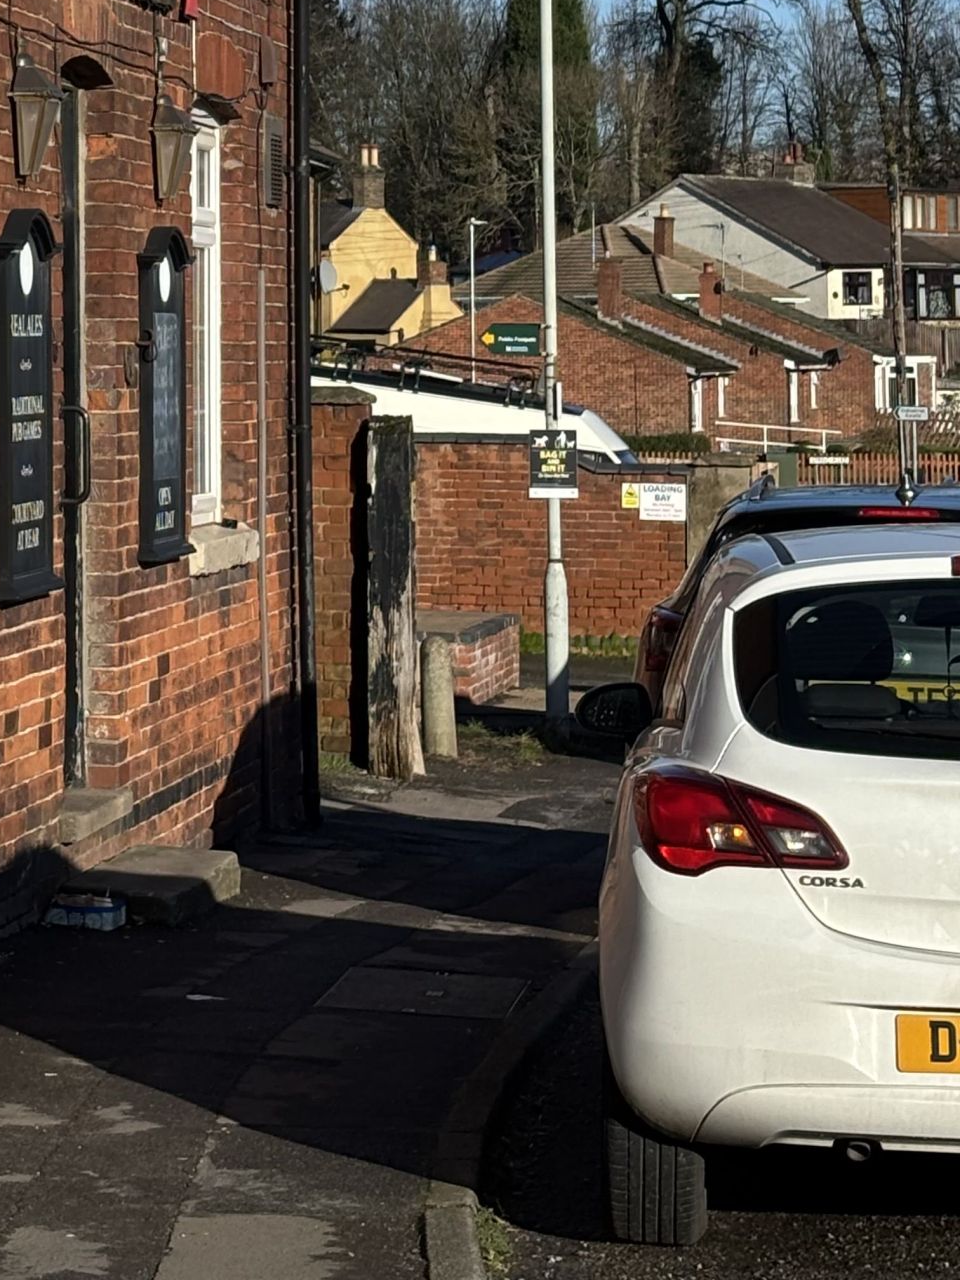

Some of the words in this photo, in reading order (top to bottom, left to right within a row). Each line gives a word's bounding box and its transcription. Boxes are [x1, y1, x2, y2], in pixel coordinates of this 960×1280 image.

[27, 313, 44, 337] ALES
[11, 394, 45, 416] RADITIONAL
[539, 450, 558, 459] BAG
[558, 450, 567, 459] IT
[541, 464, 556, 472] BIN
[557, 464, 566, 472] IT
[157, 486, 172, 507] OPEN
[643, 485, 683, 493] LOADING
[155, 511, 165, 531] ALL
[164, 509, 176, 530] DAY
[16, 530, 25, 551] AT
[799, 875, 865, 889] CORSA
[929, 1020, 960, 1063] D
